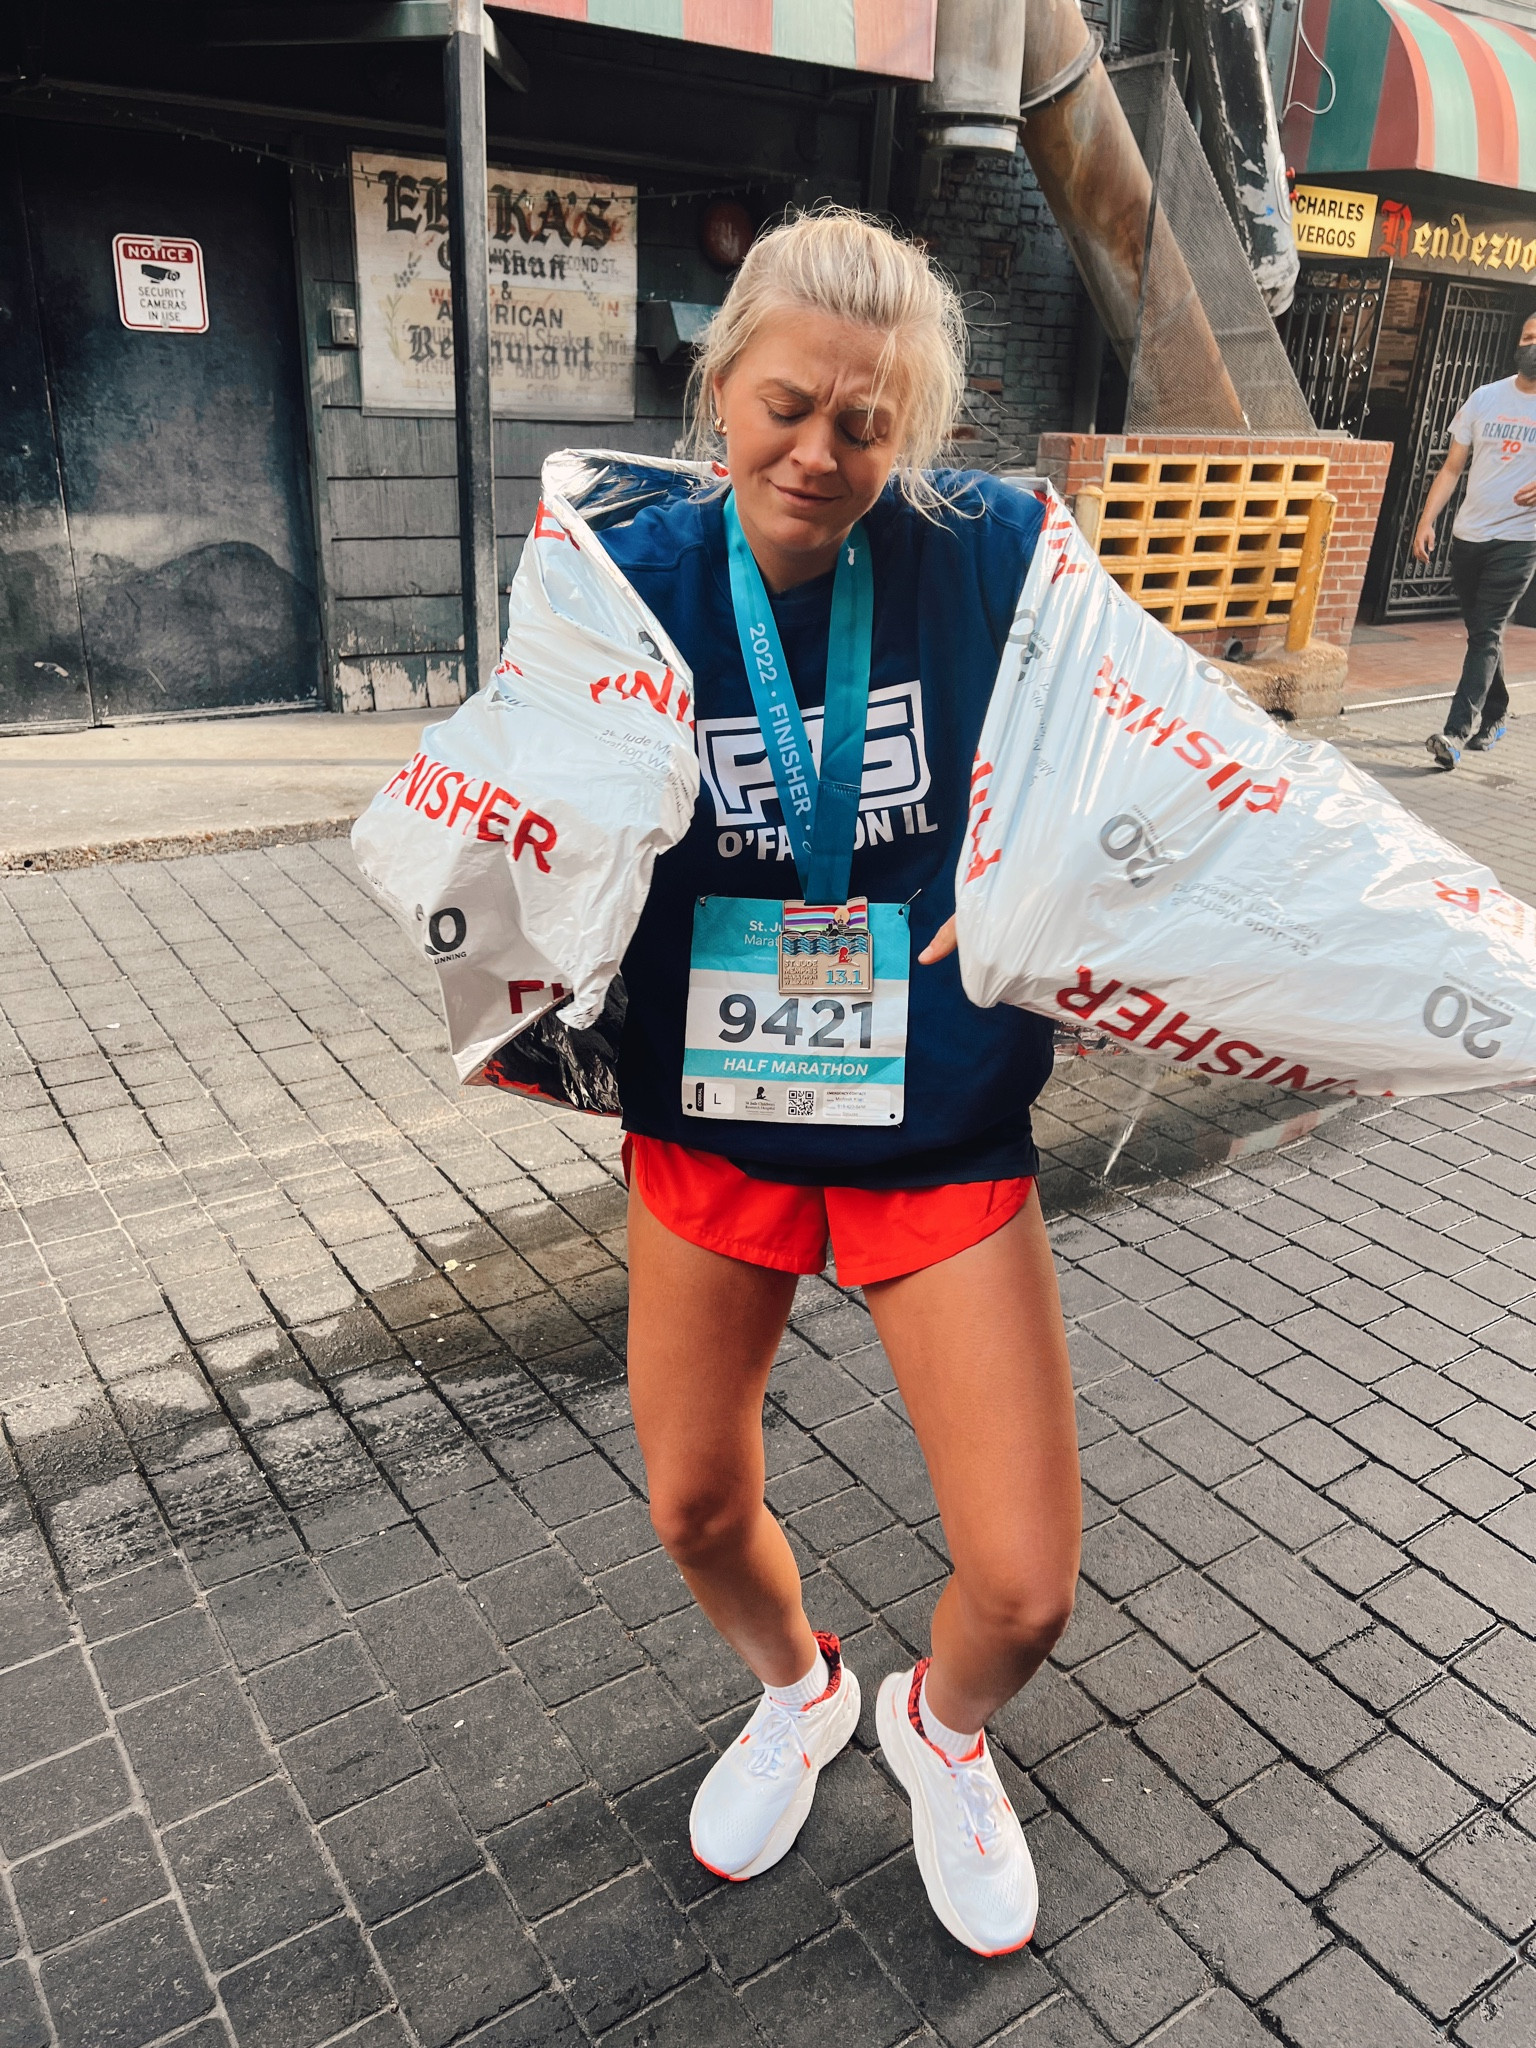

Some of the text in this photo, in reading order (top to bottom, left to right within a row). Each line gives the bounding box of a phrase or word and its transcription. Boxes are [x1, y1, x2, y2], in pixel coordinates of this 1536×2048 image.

[378, 170, 613, 250] ERKA'S
[1296, 195, 1365, 221] CHARLES
[1297, 224, 1356, 249] VERGOS
[128, 245, 188, 261] NOTICE
[437, 240, 567, 280] Gman
[138, 287, 186, 299] SECURITY
[501, 280, 512, 300] &
[140, 299, 187, 310] CAMERAS
[148, 311, 181, 322] IN USE
[437, 300, 563, 329] ARICAN
[408, 324, 594, 370] Reaurant
[1501, 440, 1522, 453] 70
[750, 623, 777, 684] 2022
[768, 703, 812, 816] FINISHER
[717, 803, 938, 862] O'FAON IL
[425, 906, 467, 954] 0
[749, 920, 783, 932] St. Ju
[744, 934, 779, 947] Marat
[433, 951, 467, 965] UNNING
[826, 970, 863, 986] 13.1
[718, 993, 873, 1049] 9421
[1055, 965, 1350, 1093] NISHER
[1423, 985, 1513, 1059] 20
[723, 1057, 868, 1076] HALF MARATHON
[714, 1093, 722, 1105] L
